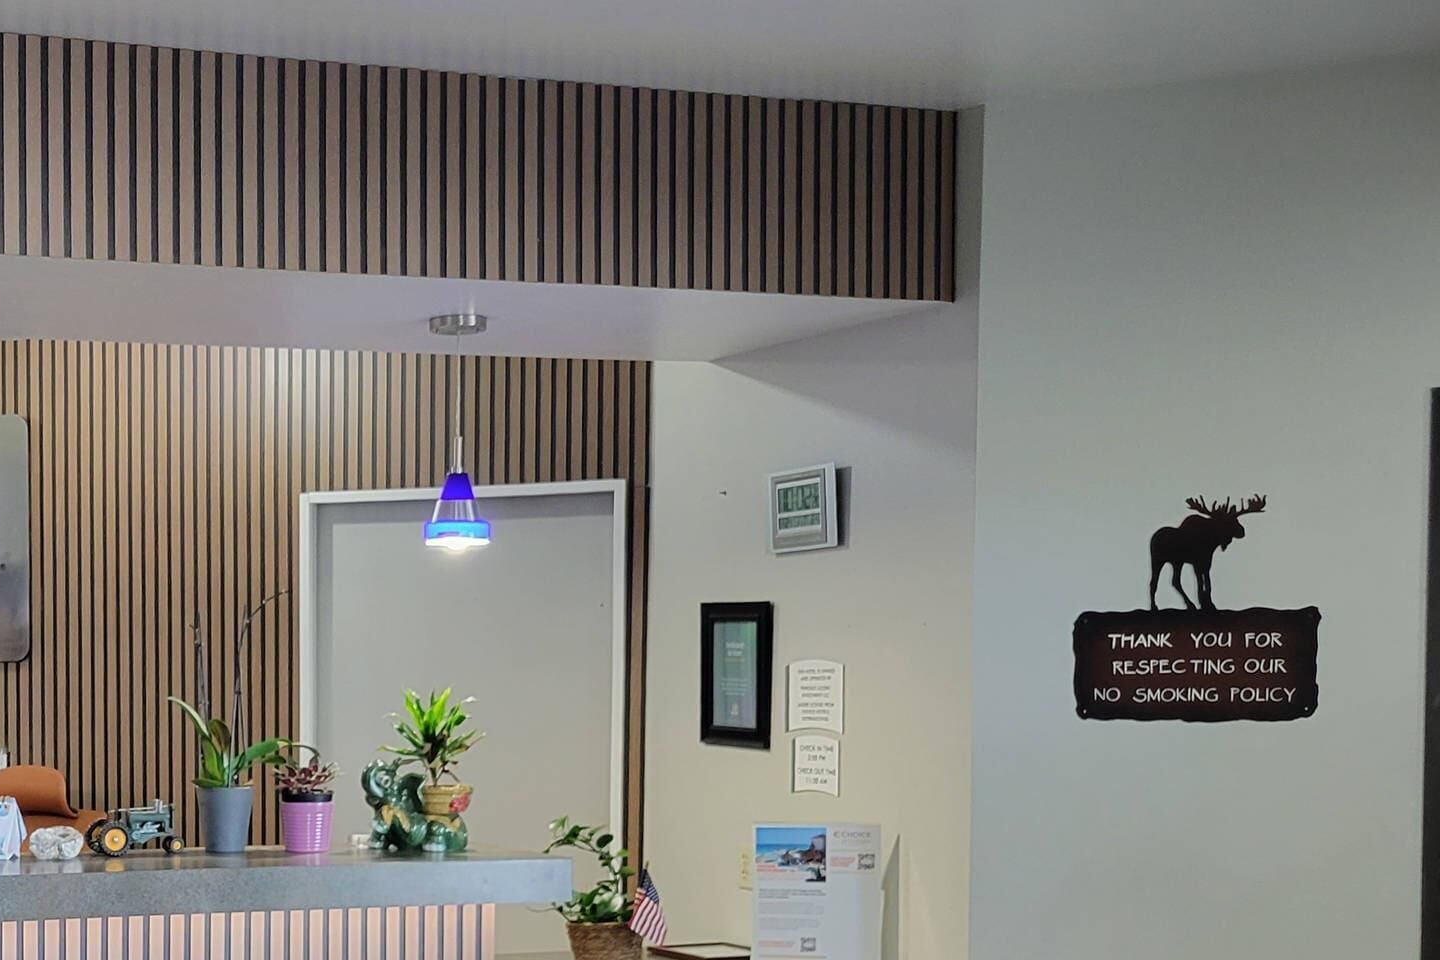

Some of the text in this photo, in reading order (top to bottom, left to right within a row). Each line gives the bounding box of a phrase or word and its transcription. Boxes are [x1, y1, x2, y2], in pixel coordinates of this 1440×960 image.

[1108, 632, 1283, 649] THANK YOU FOR
[1112, 658, 1287, 675] RESPECTING OUR
[1094, 687, 1296, 703] NO SMOKING POLICY
